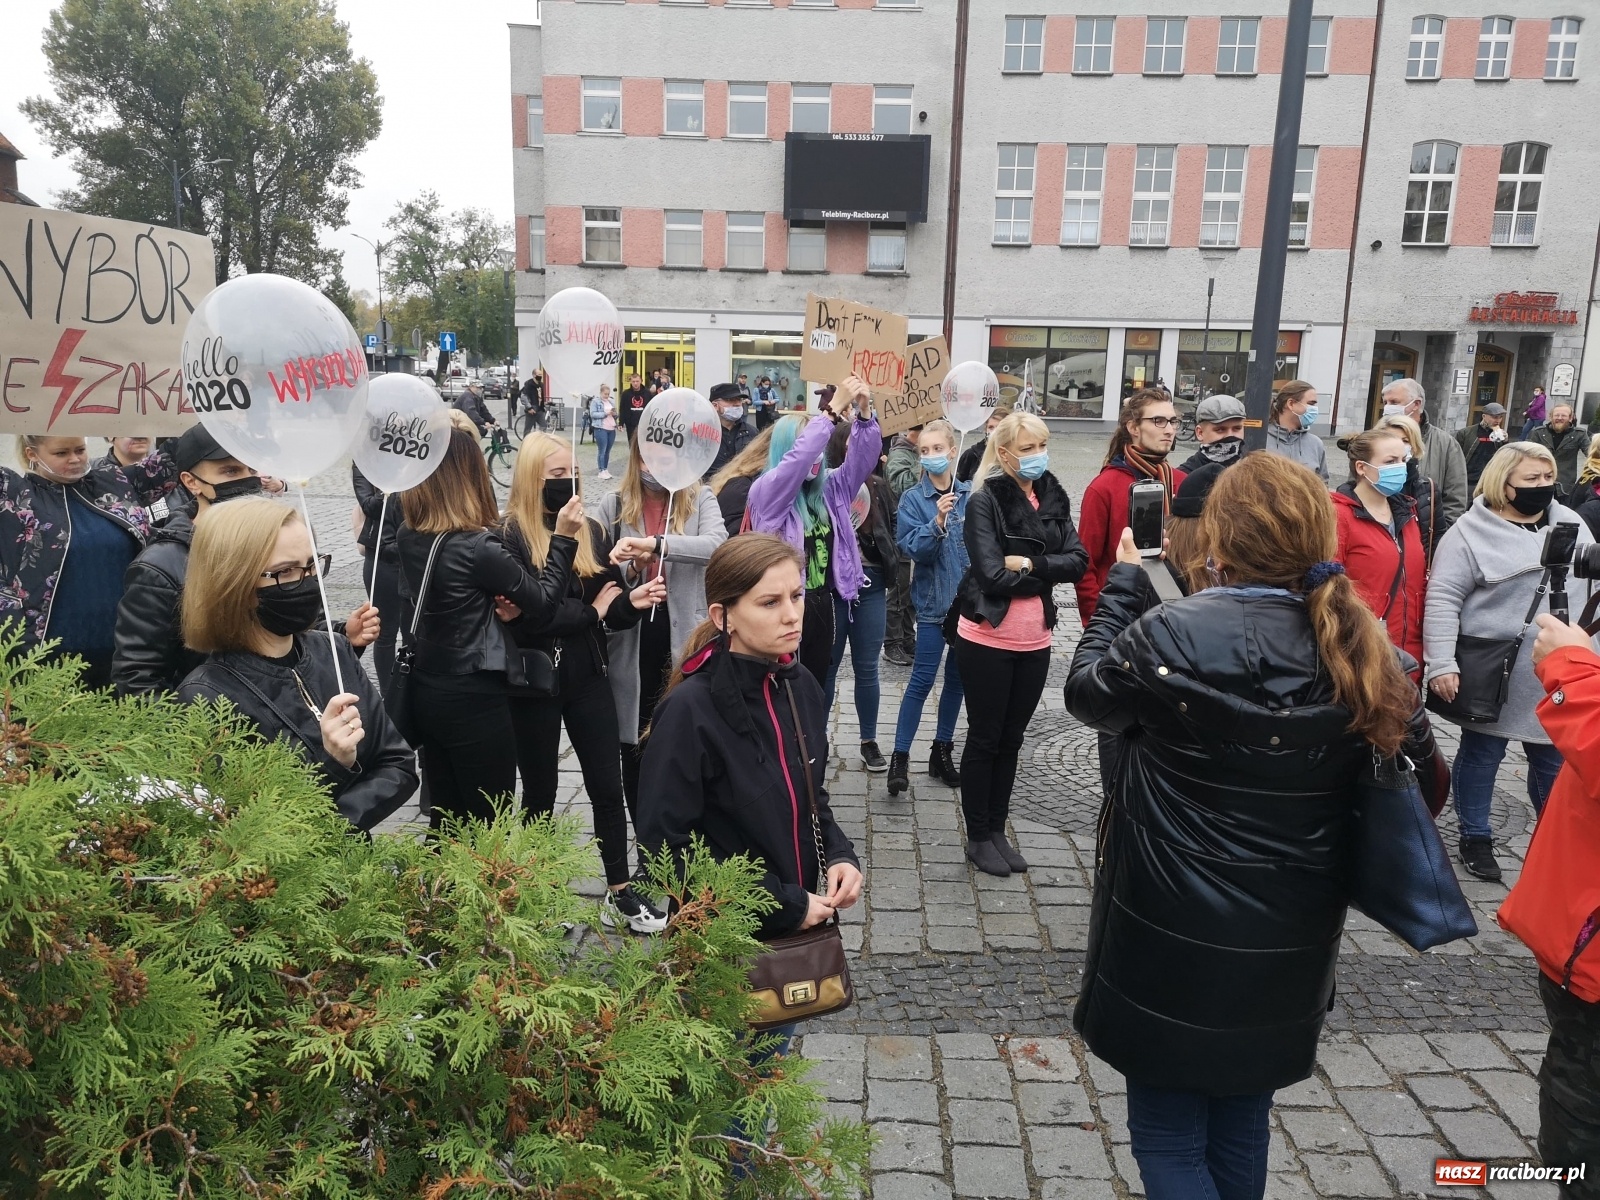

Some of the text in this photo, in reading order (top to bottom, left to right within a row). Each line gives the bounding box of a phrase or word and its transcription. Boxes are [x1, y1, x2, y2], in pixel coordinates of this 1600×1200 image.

[821, 210, 889, 219] Telebimy-Raciborz.pl
[368, 336, 377, 347] P
[182, 335, 239, 381] hello
[187, 378, 252, 413] 2020
[385, 411, 433, 443] hello
[649, 408, 686, 432] hello
[379, 433, 430, 460] 2020
[645, 426, 684, 449] 2020
